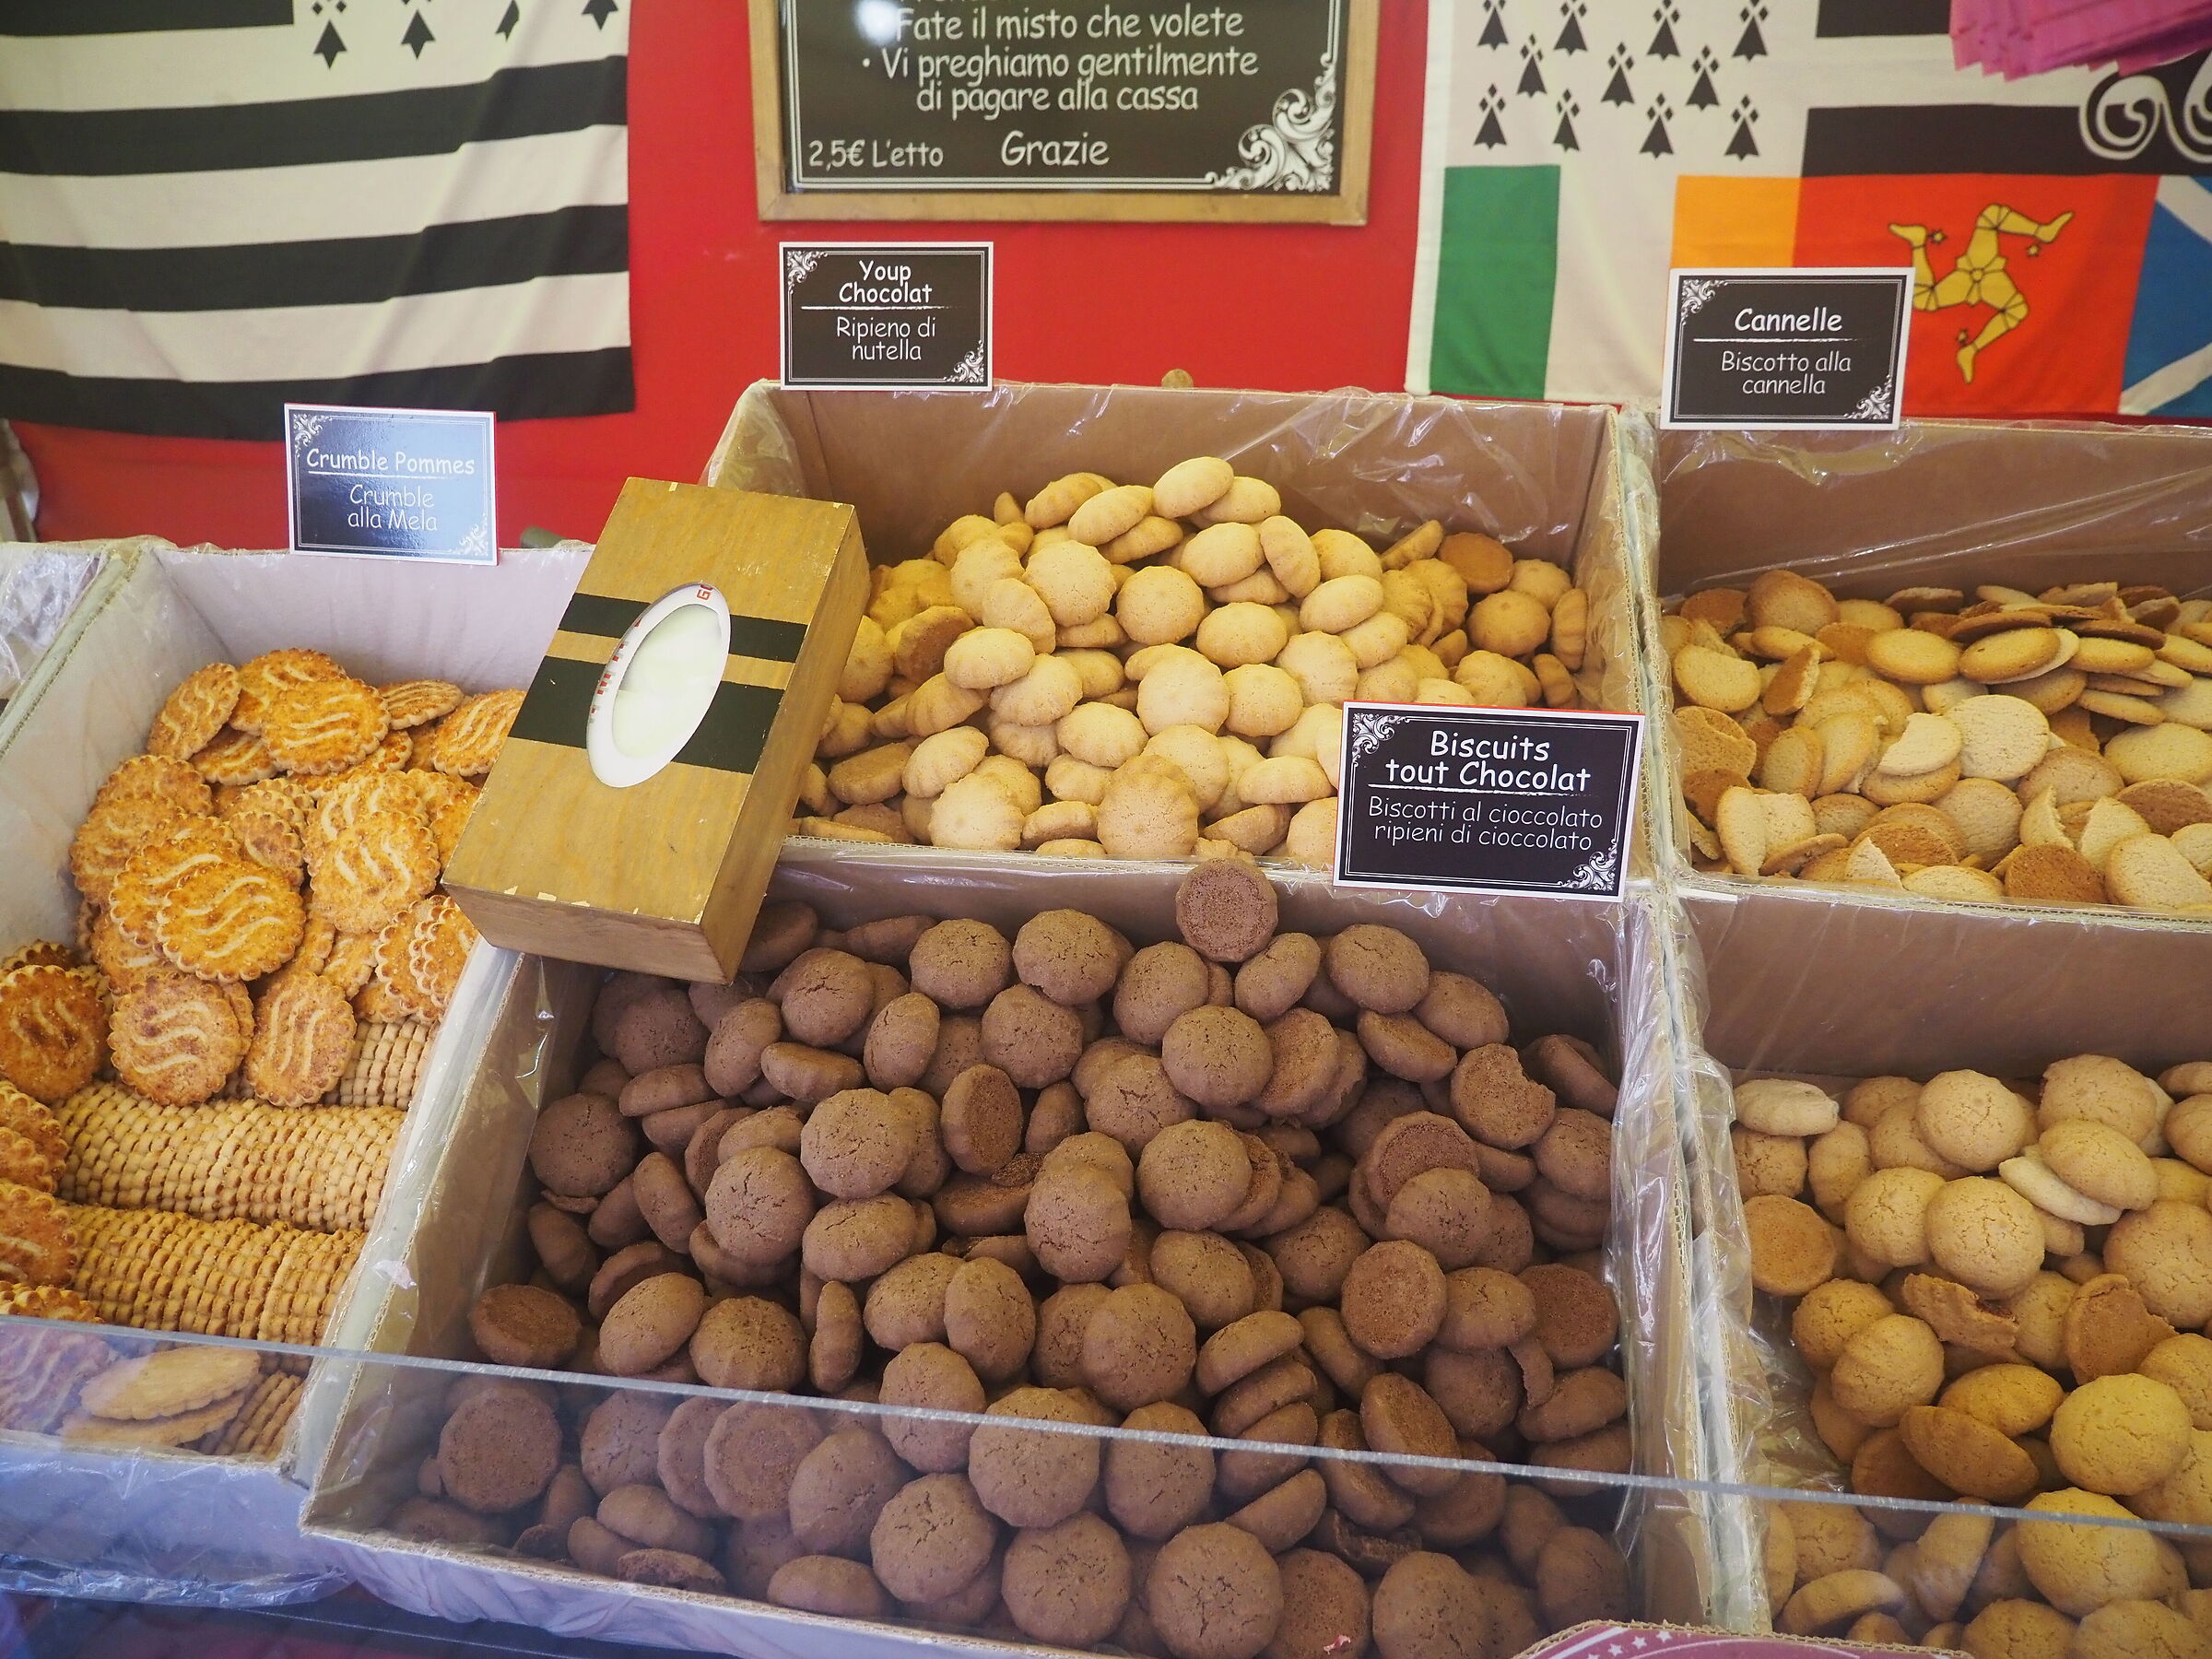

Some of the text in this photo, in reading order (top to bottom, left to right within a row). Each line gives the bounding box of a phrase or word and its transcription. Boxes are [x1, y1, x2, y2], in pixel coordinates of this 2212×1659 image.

[897, 5, 1243, 41] Fate il misto che volete
[882, 46, 1258, 88] Vi preghiamo gentilmente
[917, 79, 1198, 120] di pagare alla cassa
[809, 139, 944, 171] 2,5€ L'etto
[1001, 130, 1109, 166] Grazie
[859, 260, 911, 287] Youp
[840, 282, 932, 303] Chocolat
[837, 316, 935, 343] Ripieno di
[1735, 307, 1842, 331] Cannelle
[853, 339, 921, 360] nutella
[1722, 351, 1851, 371] Biscotto alla
[1743, 374, 1825, 394] cannella
[307, 449, 475, 475] Crumble Pommes
[350, 485, 434, 507] Crumble
[348, 506, 437, 531] alla Mela
[1430, 731, 1550, 761] Biscuits
[1385, 759, 1591, 792] tout Chocolat
[1370, 796, 1602, 828] Biscotti al cioccolato
[1374, 823, 1591, 850] ripieni di cioccolato
